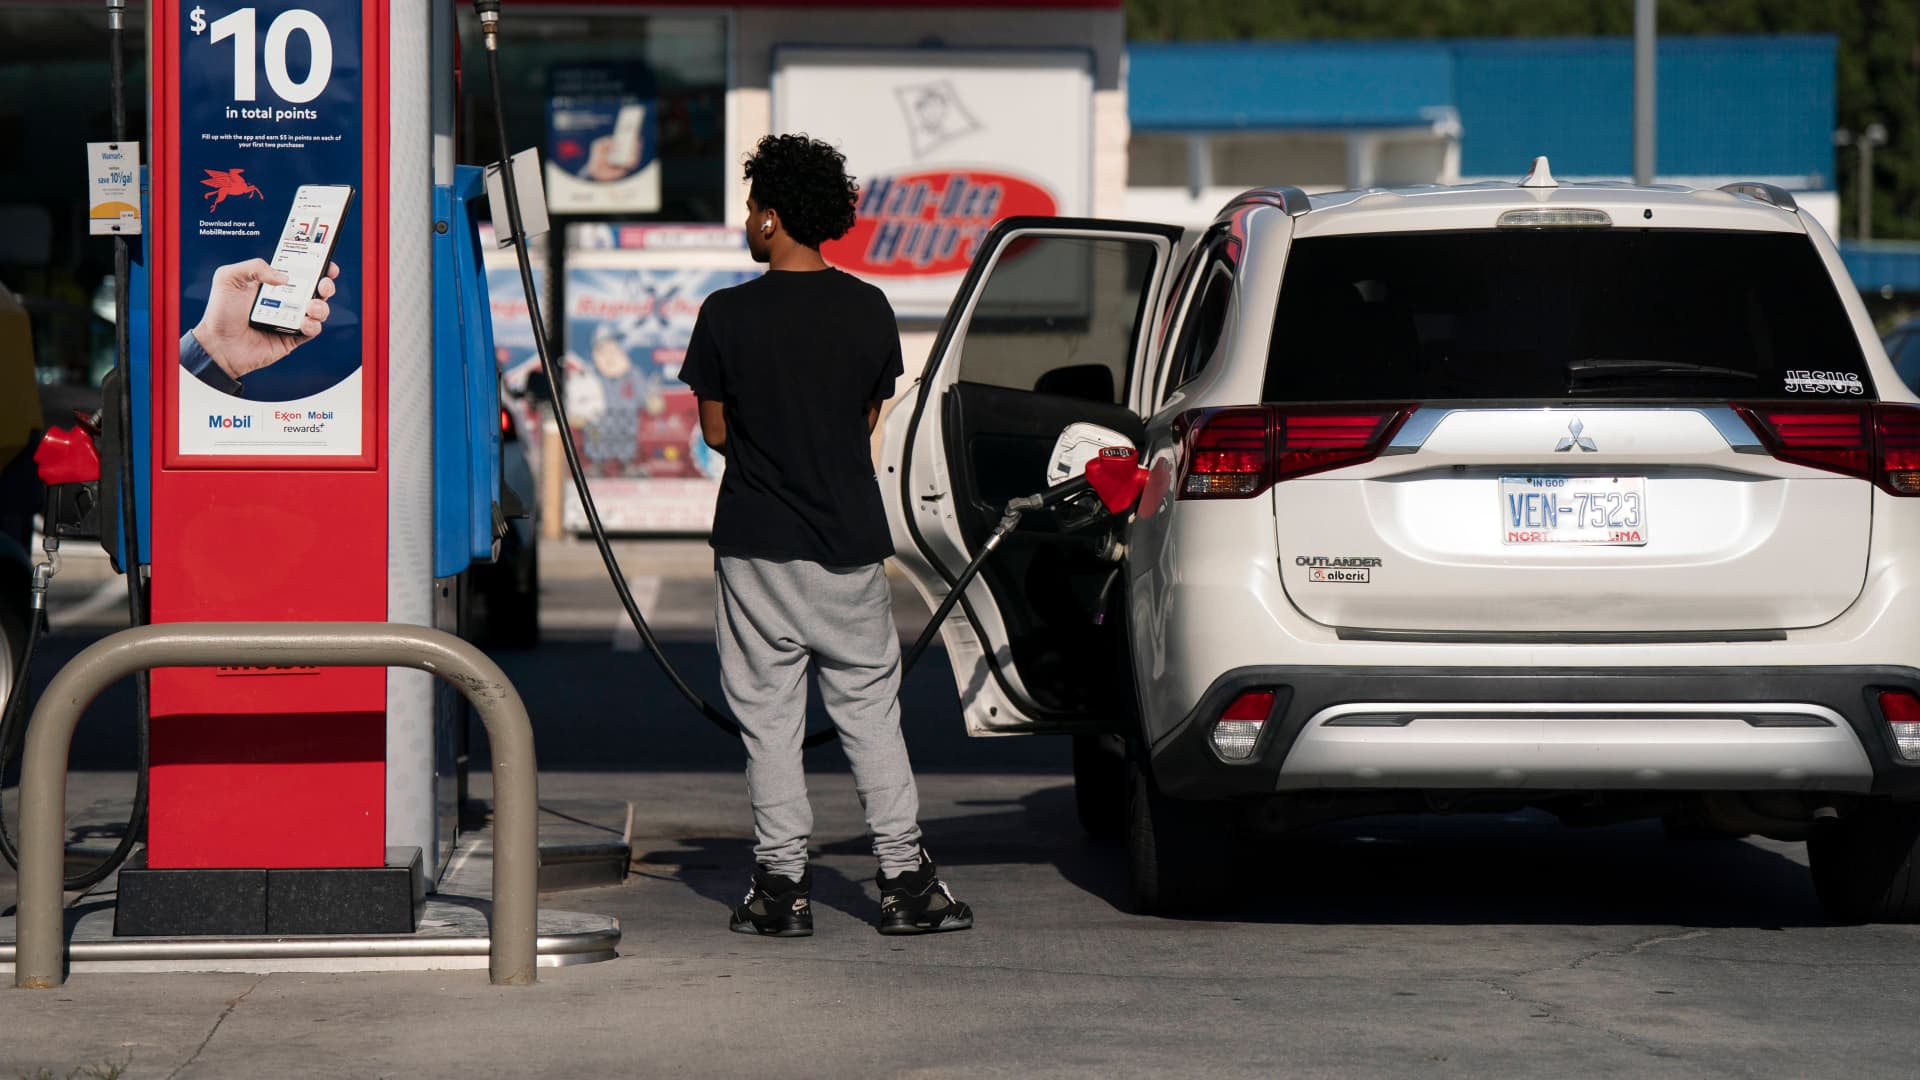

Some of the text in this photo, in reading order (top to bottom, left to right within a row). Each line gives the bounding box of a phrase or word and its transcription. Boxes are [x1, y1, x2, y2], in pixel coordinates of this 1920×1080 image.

[190, 5, 333, 104] $10
[226, 106, 317, 122] in total points
[295, 134, 312, 142] points
[276, 141, 305, 149] purchases
[199, 228, 260, 236] MobilRewards.com
[1784, 370, 1864, 395] JESUS
[209, 415, 251, 429] Mobil
[274, 411, 334, 422] Exxon Mobil
[1533, 479, 1543, 488] IN
[1544, 479, 1565, 488] GOD
[1508, 492, 1642, 528] VEN-7523
[1508, 531, 1556, 543] NORT
[1295, 556, 1383, 567] OUTLANDER
